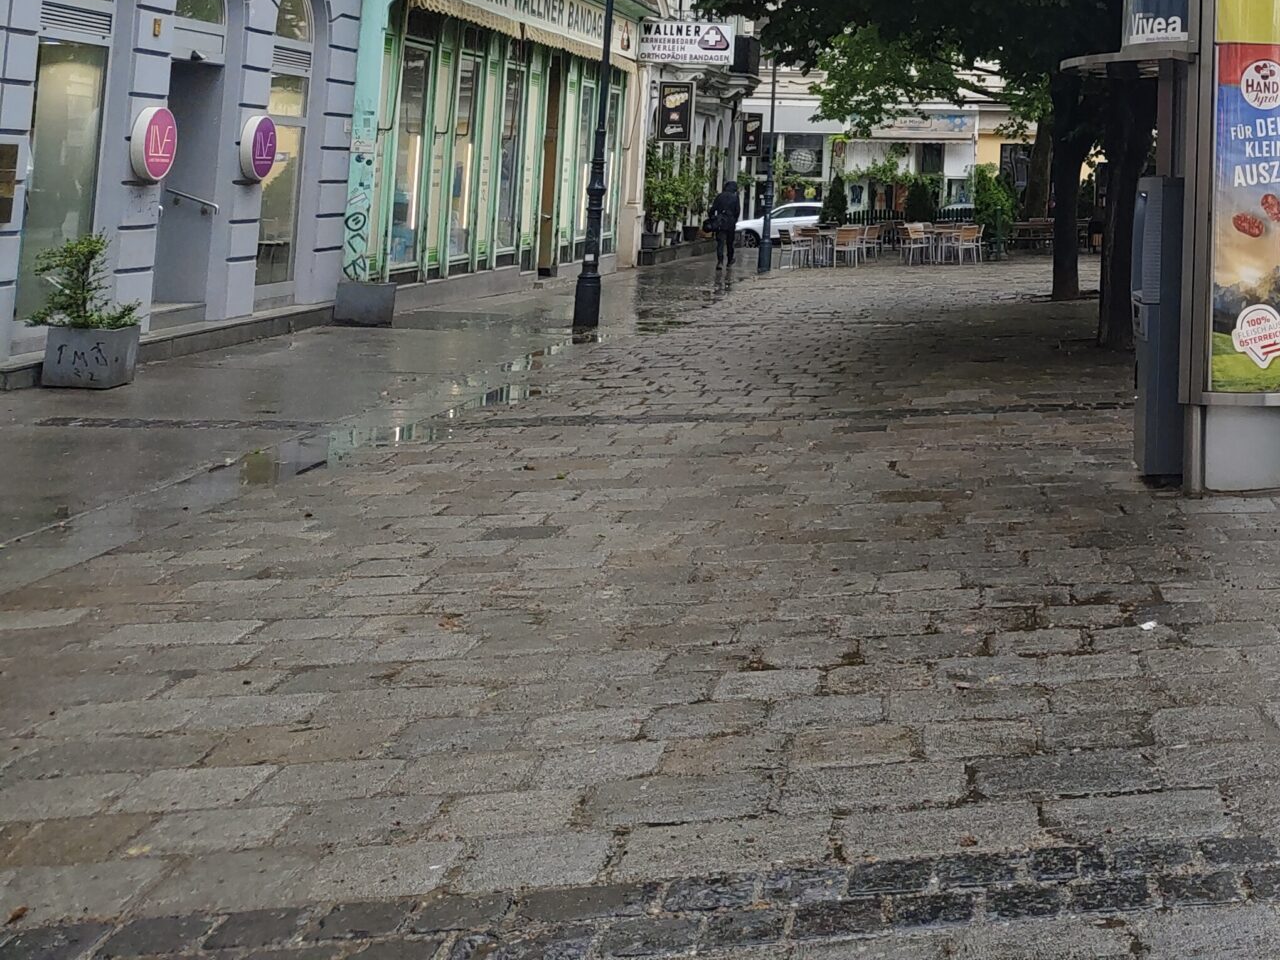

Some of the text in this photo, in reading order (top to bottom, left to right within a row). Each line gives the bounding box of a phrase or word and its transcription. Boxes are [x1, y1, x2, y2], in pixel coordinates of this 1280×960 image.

[643, 23, 701, 36] WALLNER
[1131, 12, 1182, 36] Vivea
[640, 52, 687, 60] ORTHOPÄDIE
[1230, 124, 1253, 141] FÜR
[1246, 315, 1271, 328] 100%
[1238, 326, 1267, 339] FLEISCH
